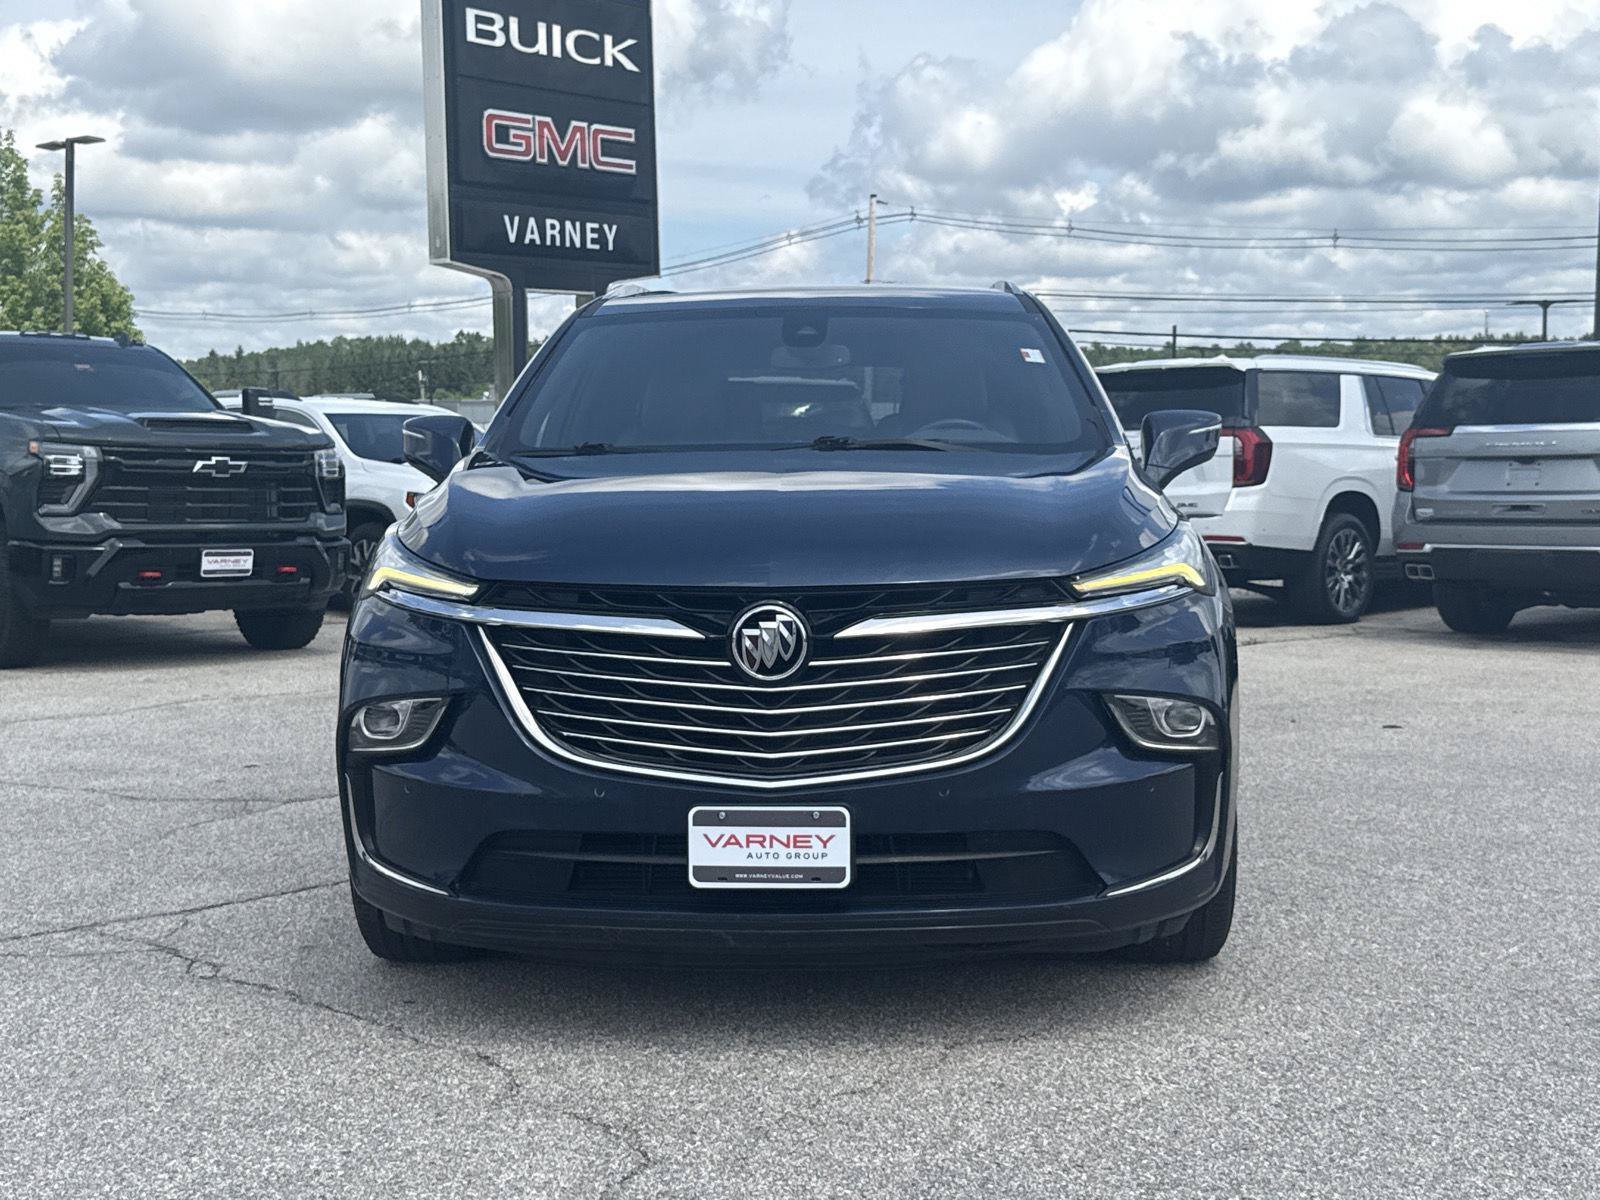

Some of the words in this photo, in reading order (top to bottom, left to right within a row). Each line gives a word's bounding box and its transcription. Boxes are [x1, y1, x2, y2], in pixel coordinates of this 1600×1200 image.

[465, 7, 641, 72] BUICK
[482, 108, 636, 174] GMC
[503, 214, 618, 251] VARNEY
[703, 833, 835, 848] VARNEY
[746, 852, 780, 860] AUTO
[785, 852, 828, 860] GROUP
